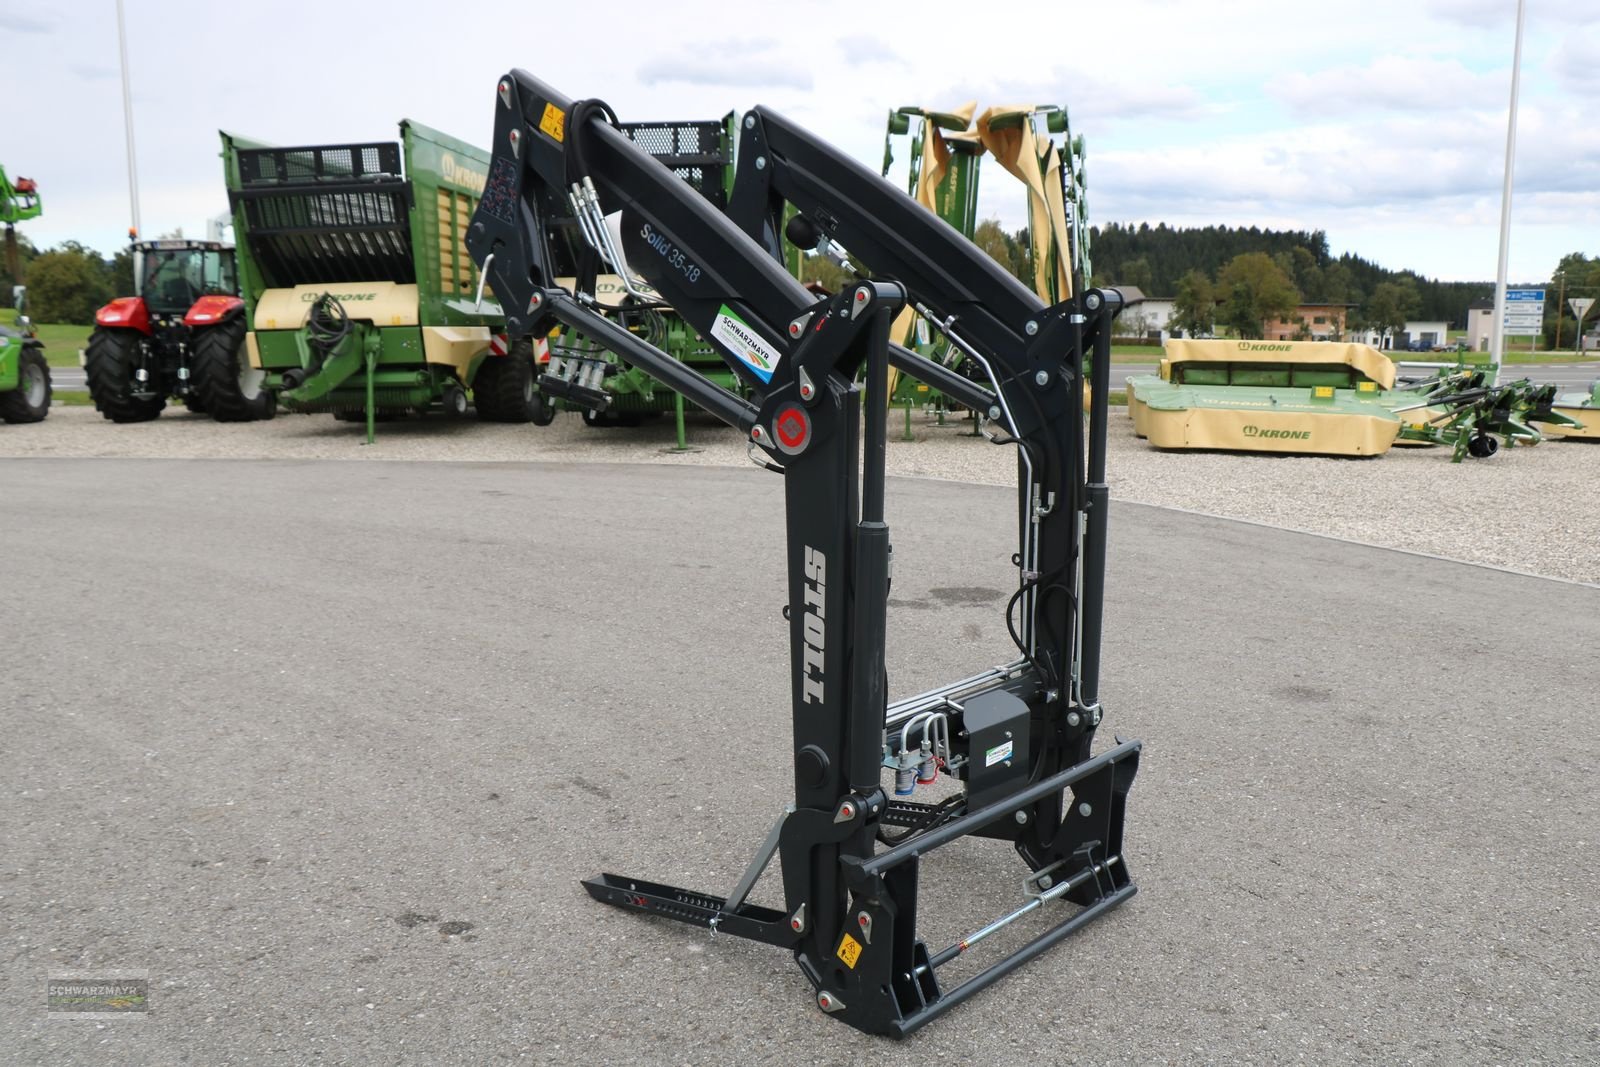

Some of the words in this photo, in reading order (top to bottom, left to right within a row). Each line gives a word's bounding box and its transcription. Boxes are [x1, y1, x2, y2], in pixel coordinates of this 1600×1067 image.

[640, 223, 671, 256] Solid
[668, 249, 700, 282] 35-18
[722, 316, 770, 360] SCHWARZMAYR
[1251, 344, 1293, 352] KRONE
[1258, 429, 1311, 440] KRONE
[803, 544, 826, 705] STOLL
